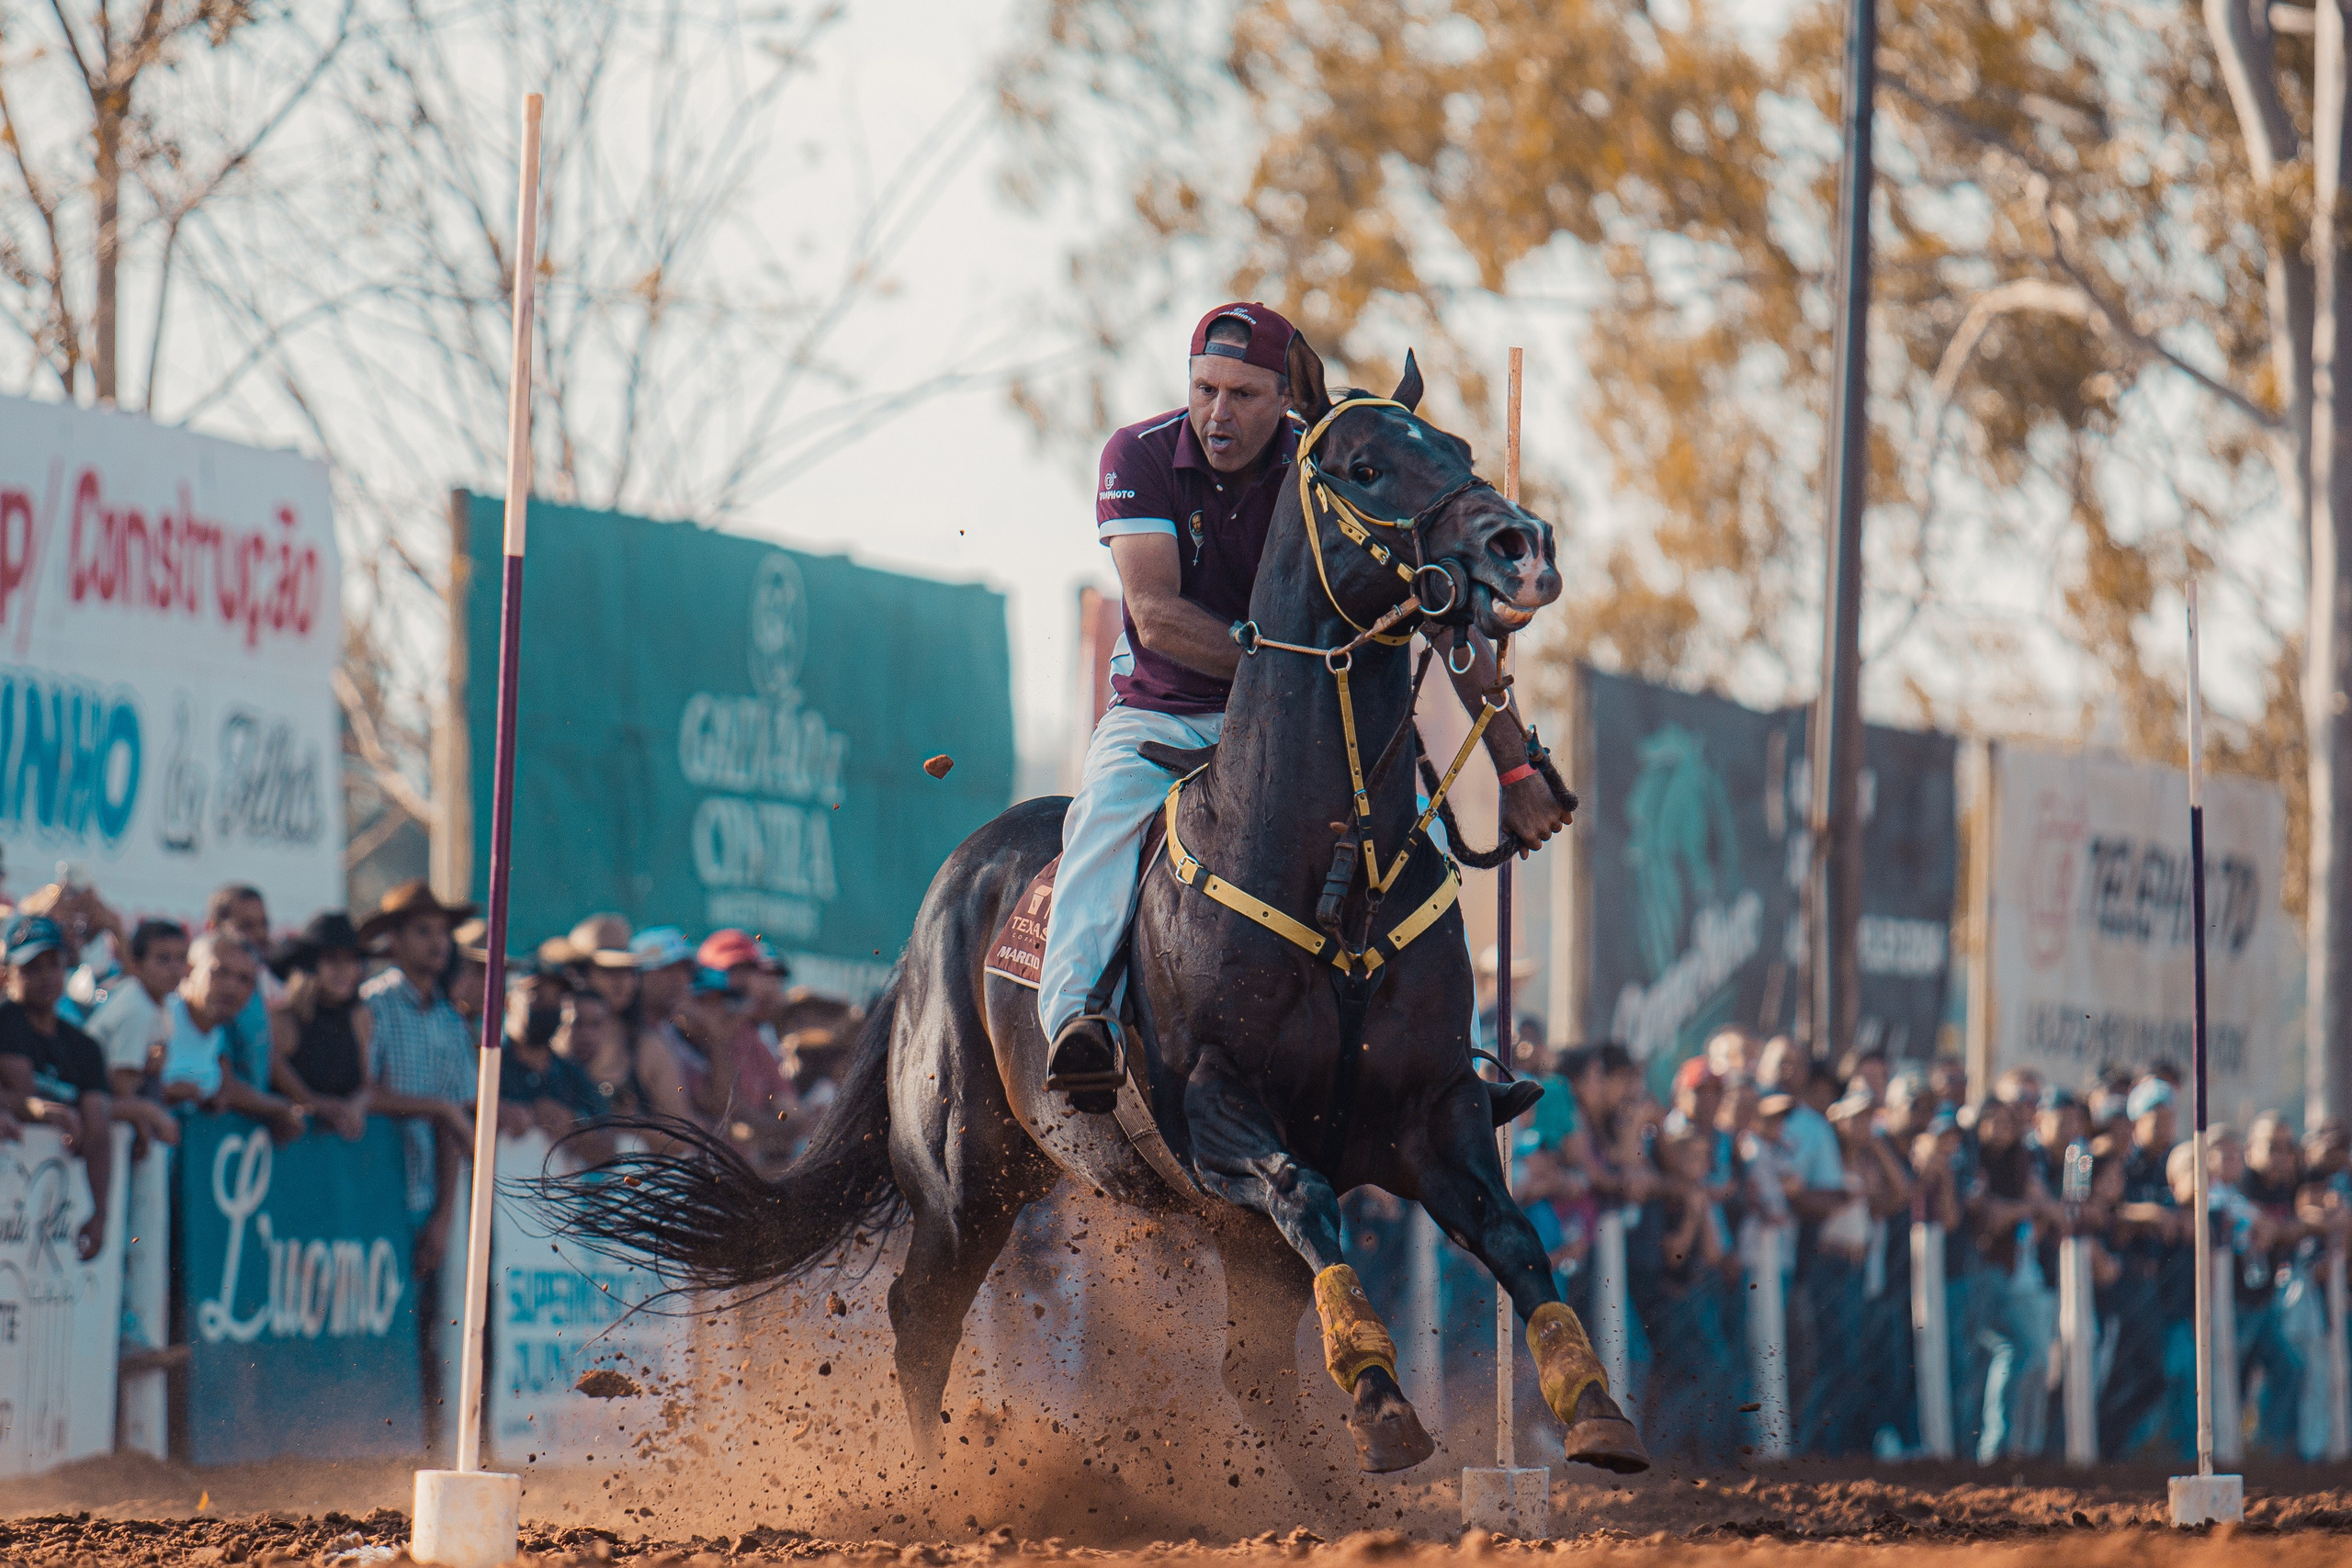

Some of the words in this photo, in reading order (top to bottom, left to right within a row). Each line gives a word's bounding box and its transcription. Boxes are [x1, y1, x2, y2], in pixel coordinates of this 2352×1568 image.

[69, 468, 322, 646] Construção
[1012, 916, 1047, 942] TEXAS
[198, 1127, 404, 1341] L'uomo
